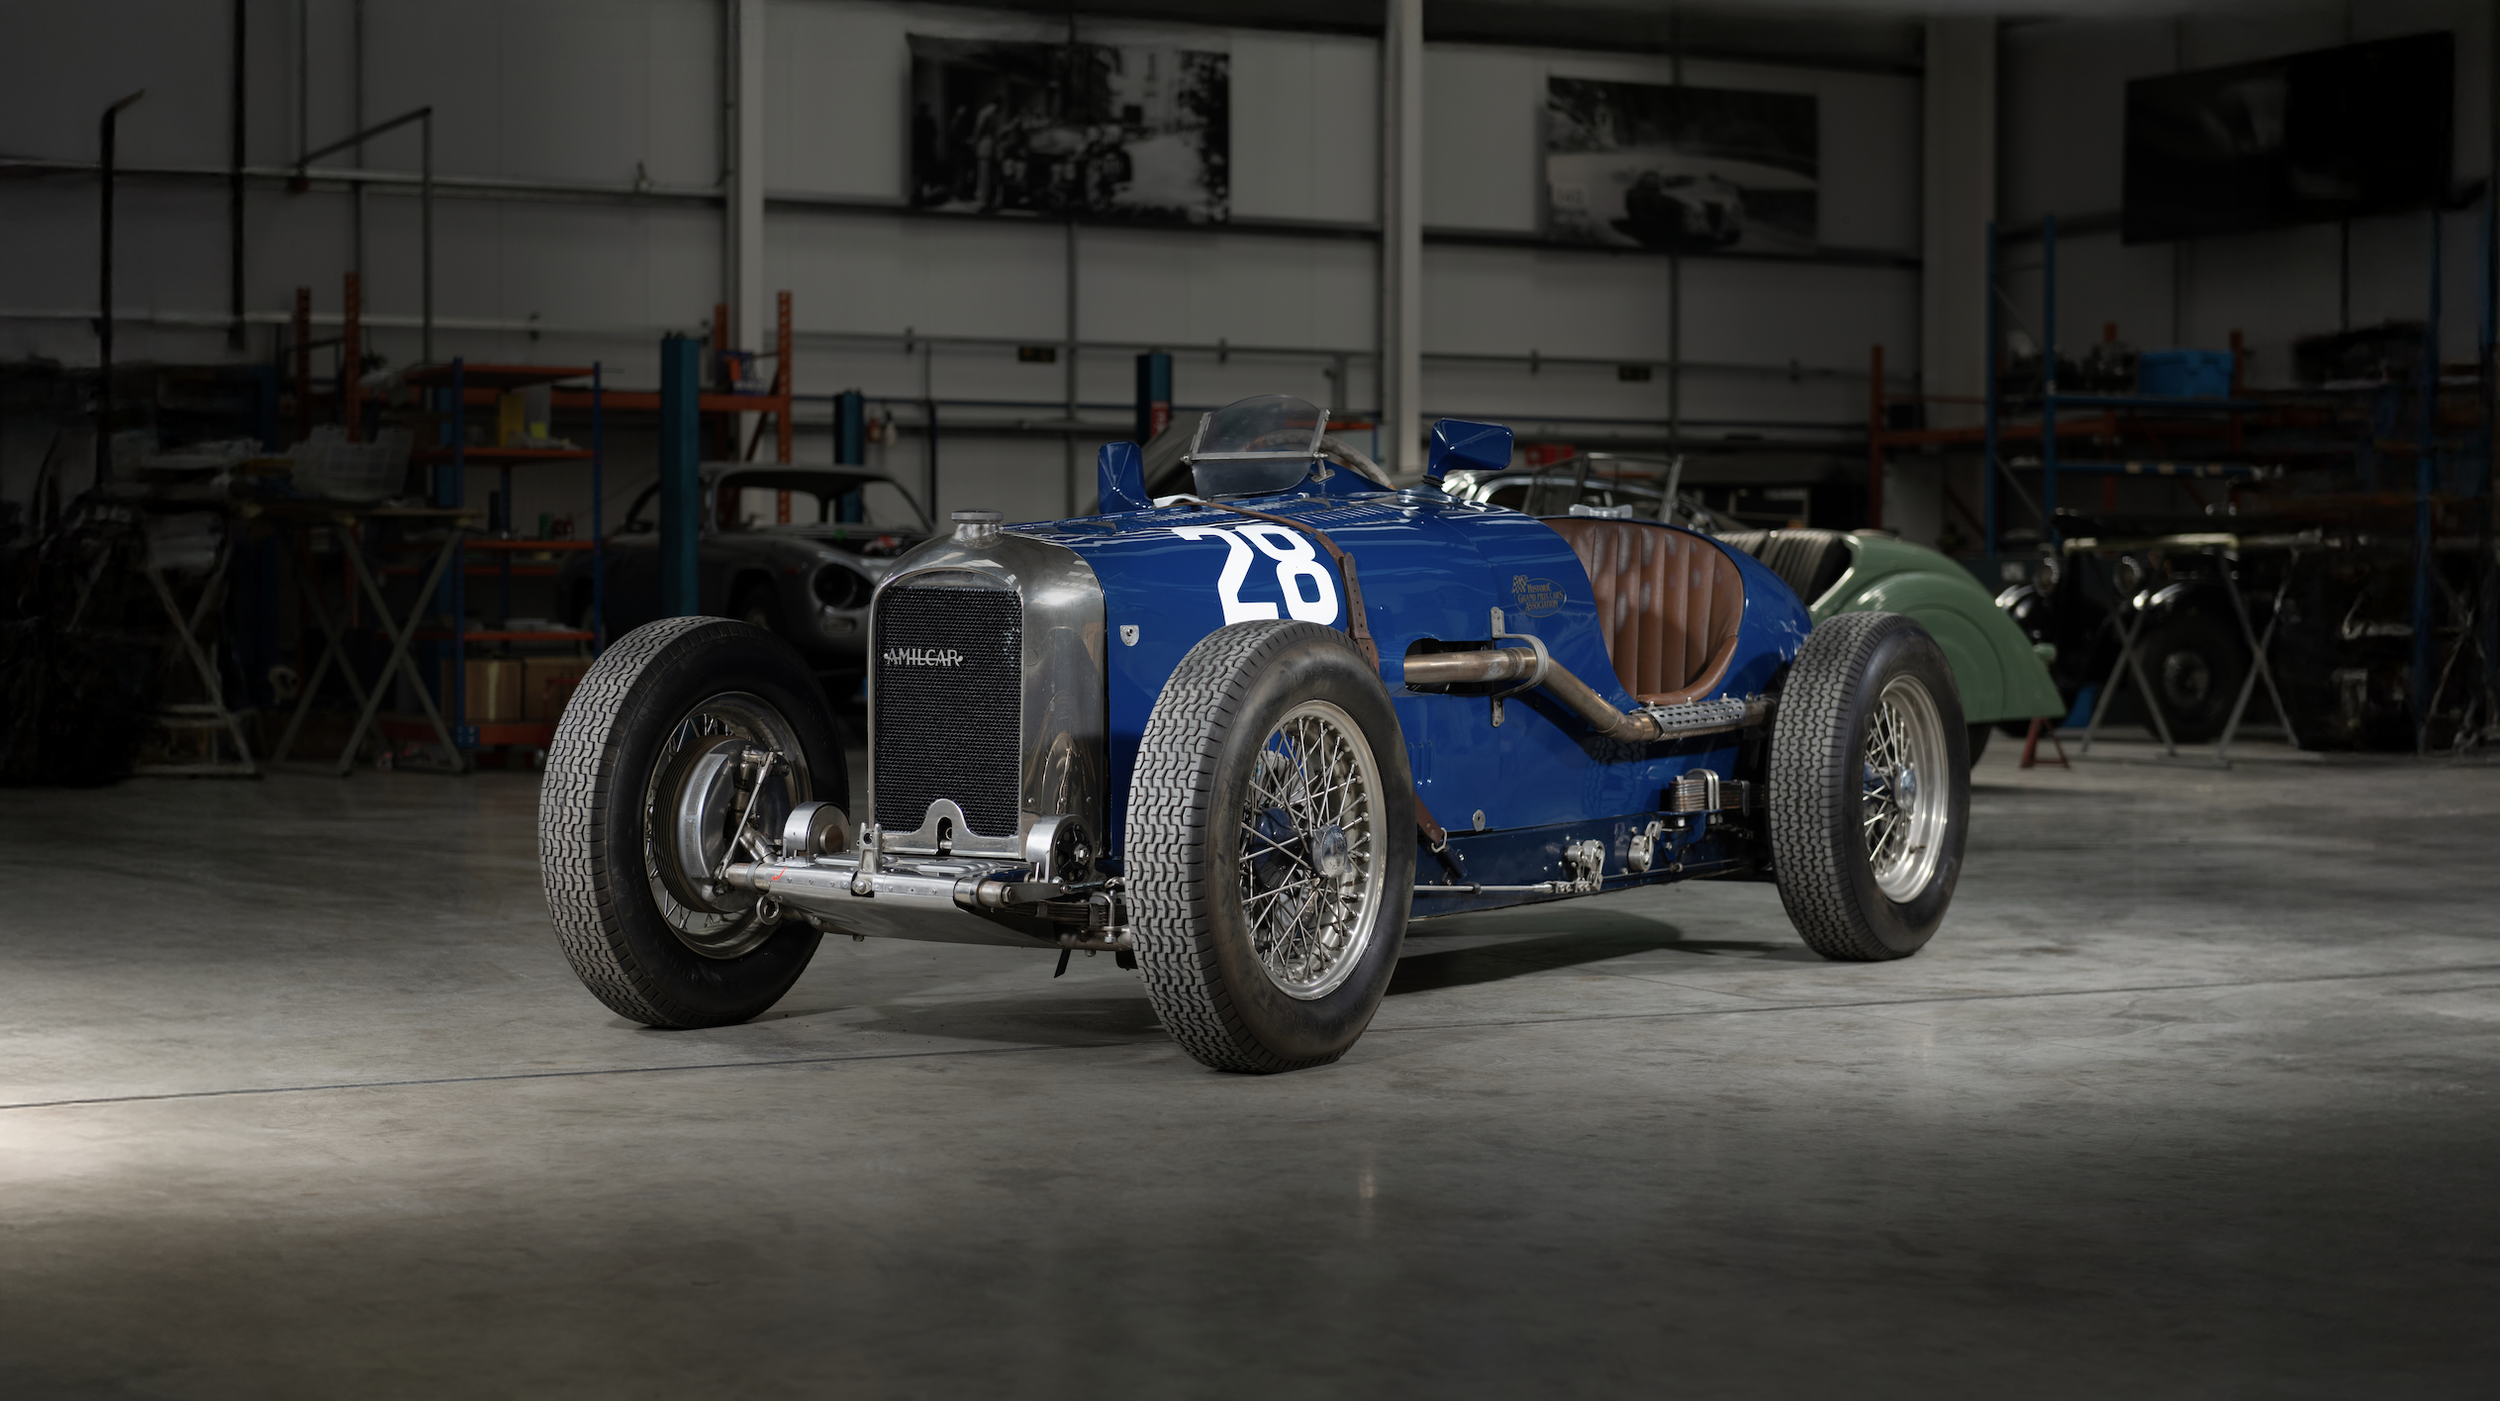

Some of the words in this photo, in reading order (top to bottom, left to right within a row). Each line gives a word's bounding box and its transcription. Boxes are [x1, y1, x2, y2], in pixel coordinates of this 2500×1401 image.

[1172, 525, 1339, 626] 28
[1517, 593, 1537, 603] GRAND
[1525, 600, 1559, 611] ASSOCIATION
[886, 647, 961, 667] AMILCAR
